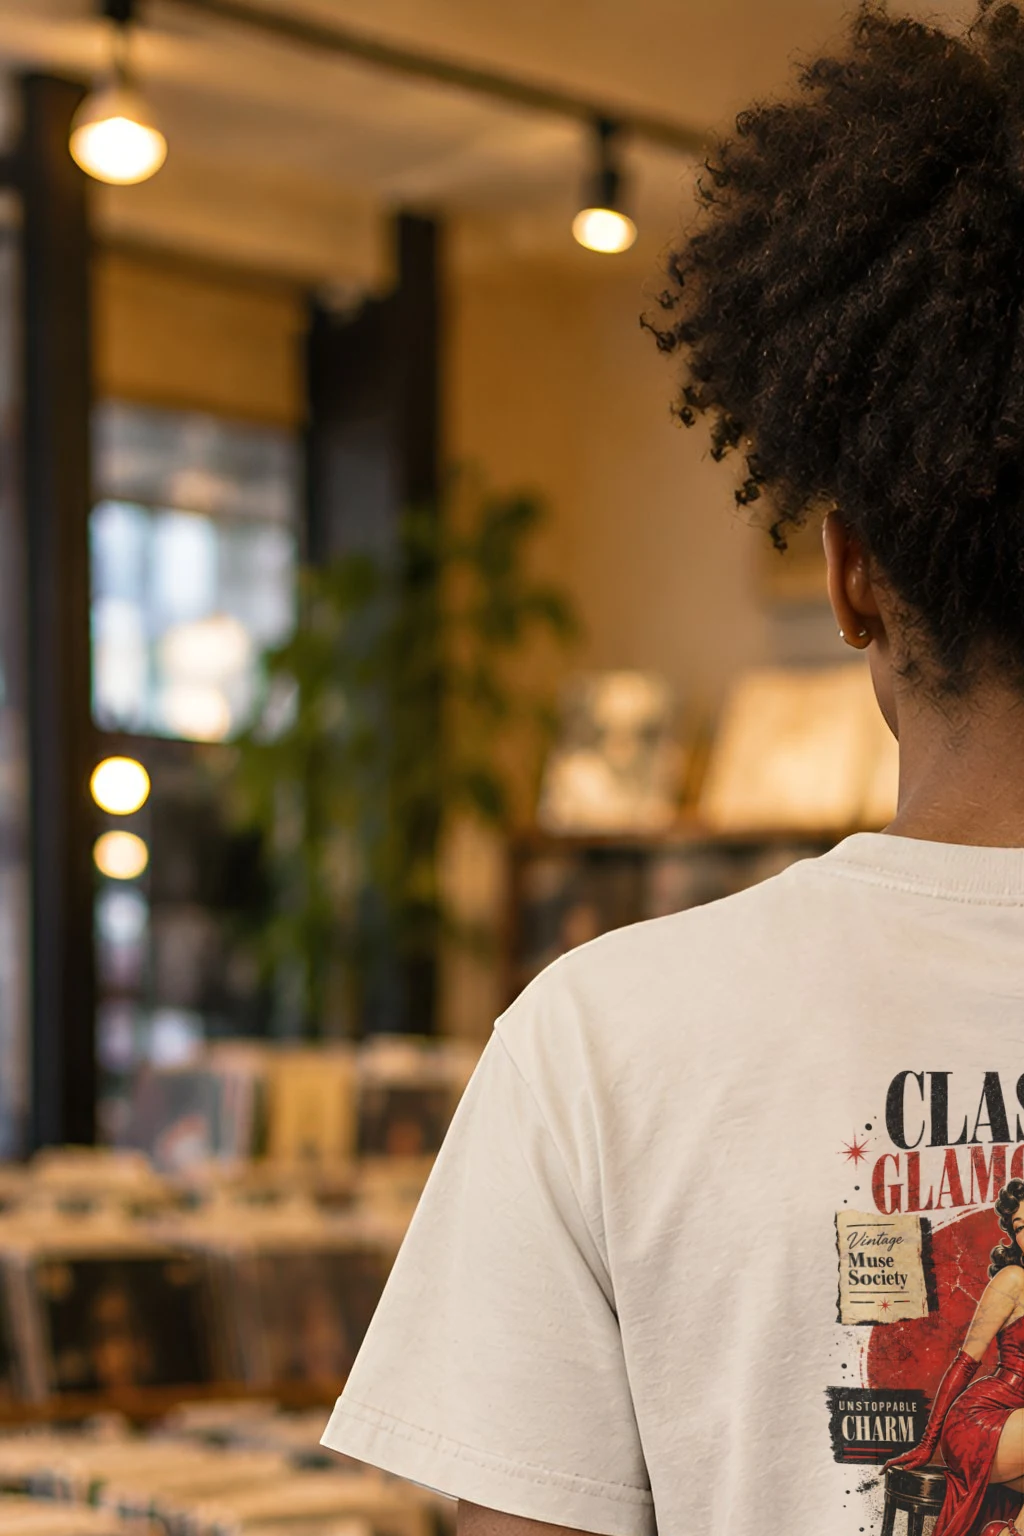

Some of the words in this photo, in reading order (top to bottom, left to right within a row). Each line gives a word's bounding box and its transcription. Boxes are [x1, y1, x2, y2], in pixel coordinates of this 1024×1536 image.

[846, 1231, 905, 1252] Vintage
[848, 1252, 895, 1268] Muse
[848, 1269, 908, 1290] Society
[838, 1400, 917, 1413] UNSTOPPABLE
[841, 1415, 915, 1442] CHARM
